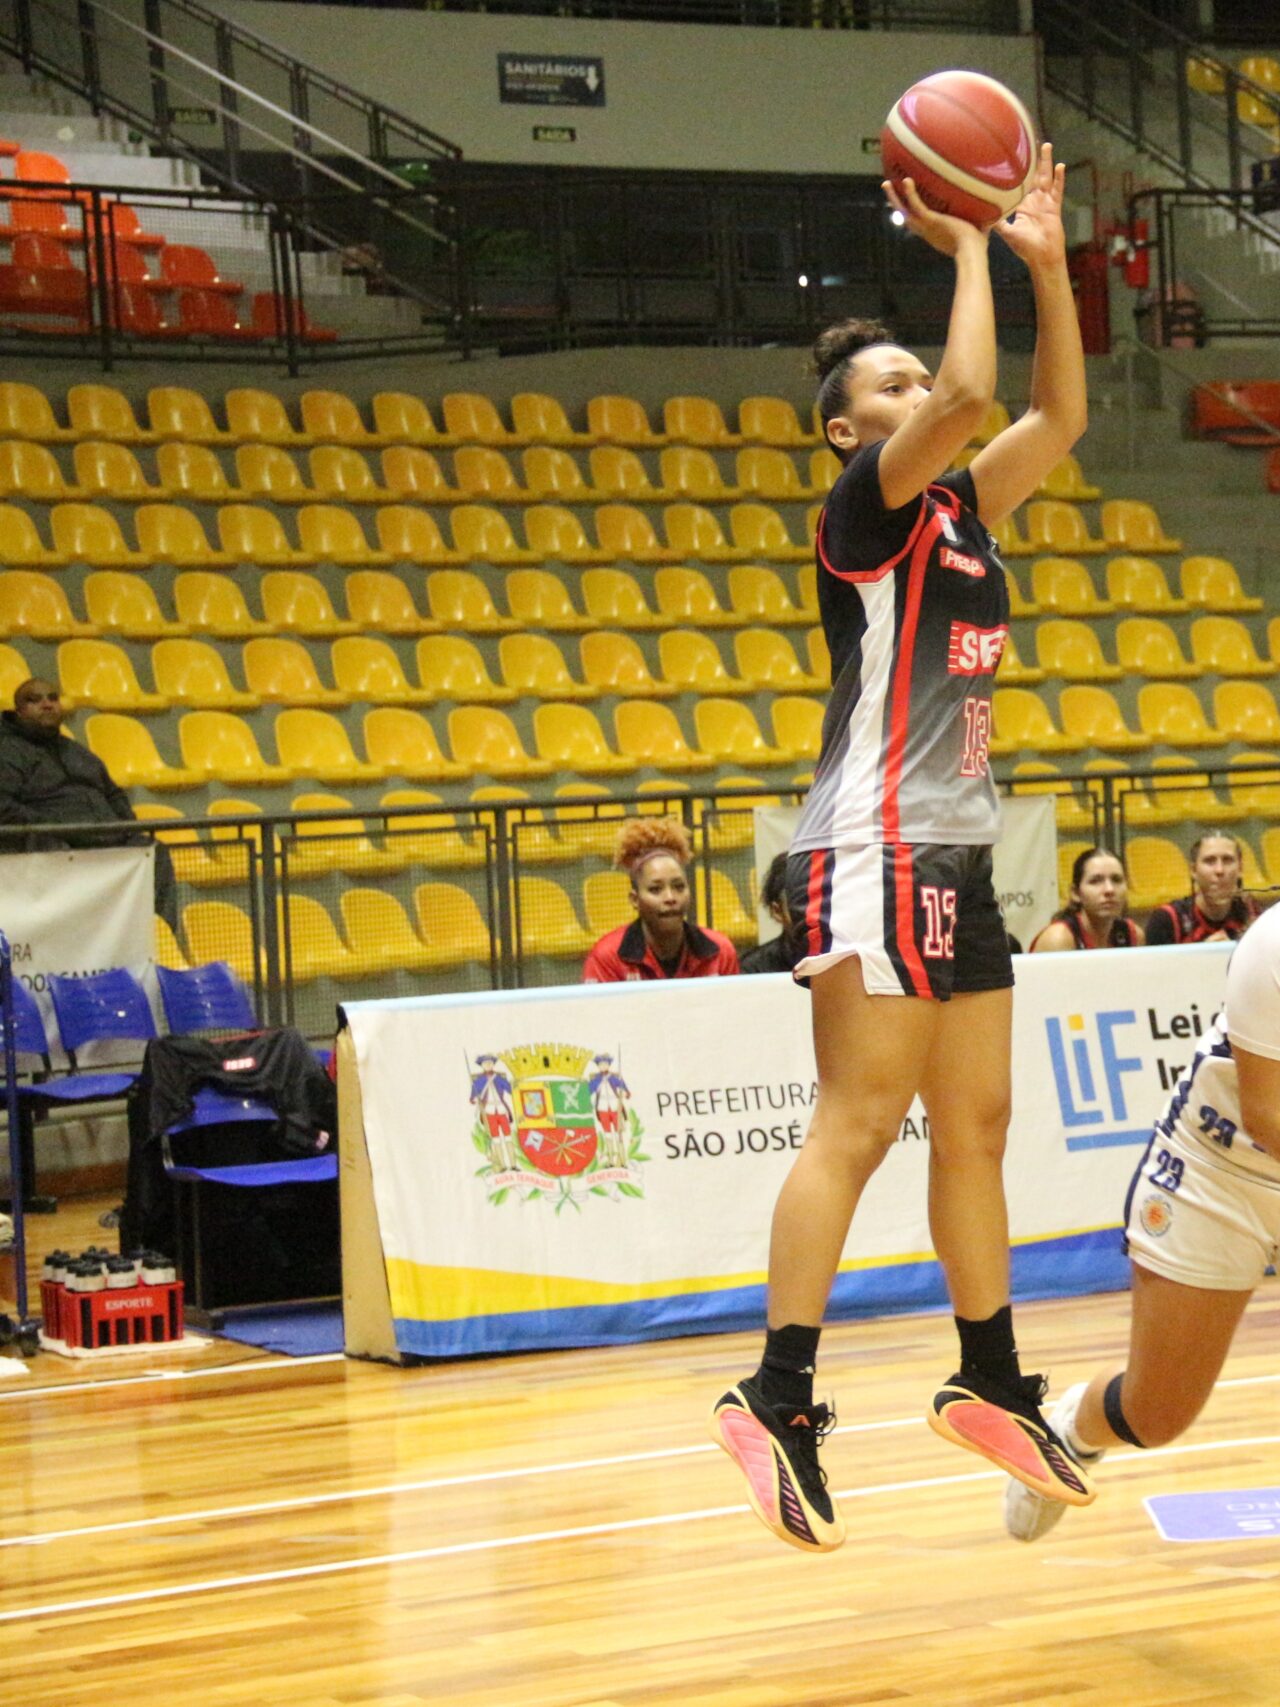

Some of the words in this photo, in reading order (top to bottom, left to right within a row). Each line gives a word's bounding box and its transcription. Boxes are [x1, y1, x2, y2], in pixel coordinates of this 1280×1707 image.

[504, 62, 587, 78] SANITÁRIOS
[1148, 1004, 1203, 1041] Lei
[664, 1128, 725, 1160] SÃO
[735, 1119, 804, 1155] JOSÉ
[1149, 1149, 1185, 1193] 23
